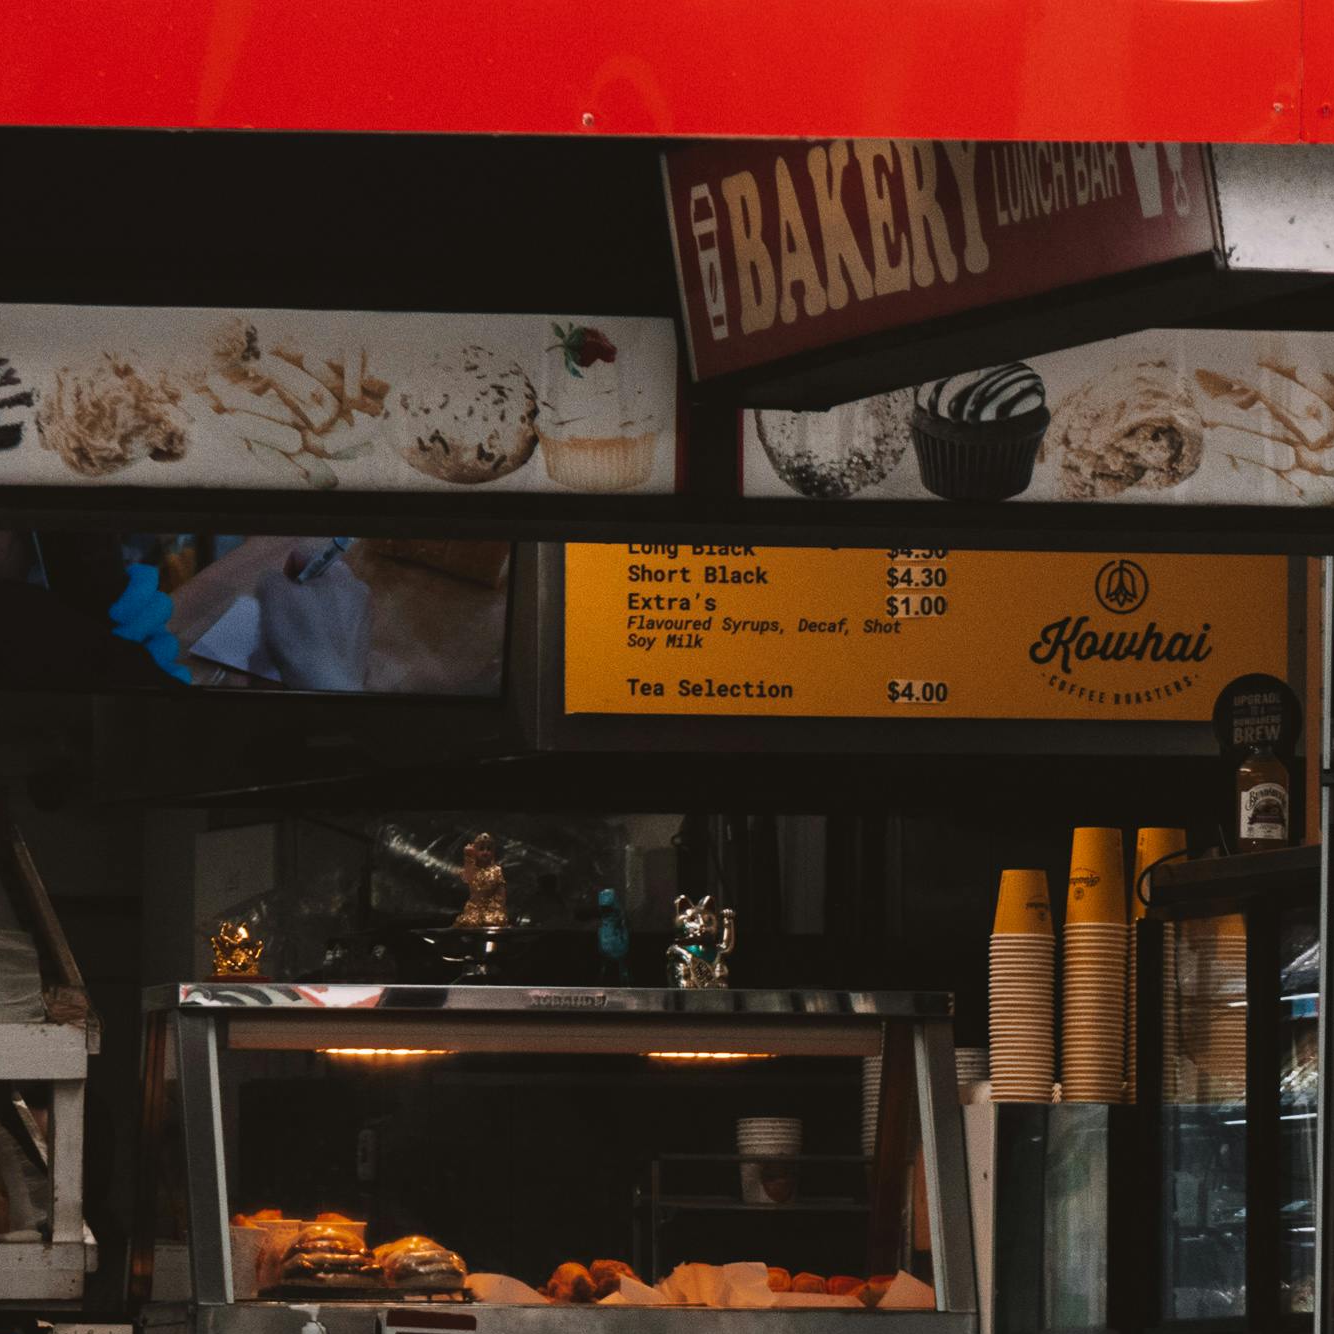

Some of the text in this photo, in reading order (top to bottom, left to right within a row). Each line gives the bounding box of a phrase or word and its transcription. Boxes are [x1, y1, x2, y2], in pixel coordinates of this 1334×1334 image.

[720, 139, 1124, 335] BAKERY LUNCH BAR
[628, 543, 679, 558] Long
[692, 544, 757, 557] Black
[627, 566, 948, 589] Short Black $4.30
[627, 593, 948, 617] Extra's $1.00
[626, 616, 902, 636] Flavoured Syrups, Decaf, Shot
[626, 634, 703, 650] Soy Milk
[1029, 616, 1213, 674] Kowhai
[627, 679, 948, 703] Tea Selection $4.00
[1048, 675, 1193, 705] COFFEE ROASTERS
[1233, 725, 1282, 745] BREW
